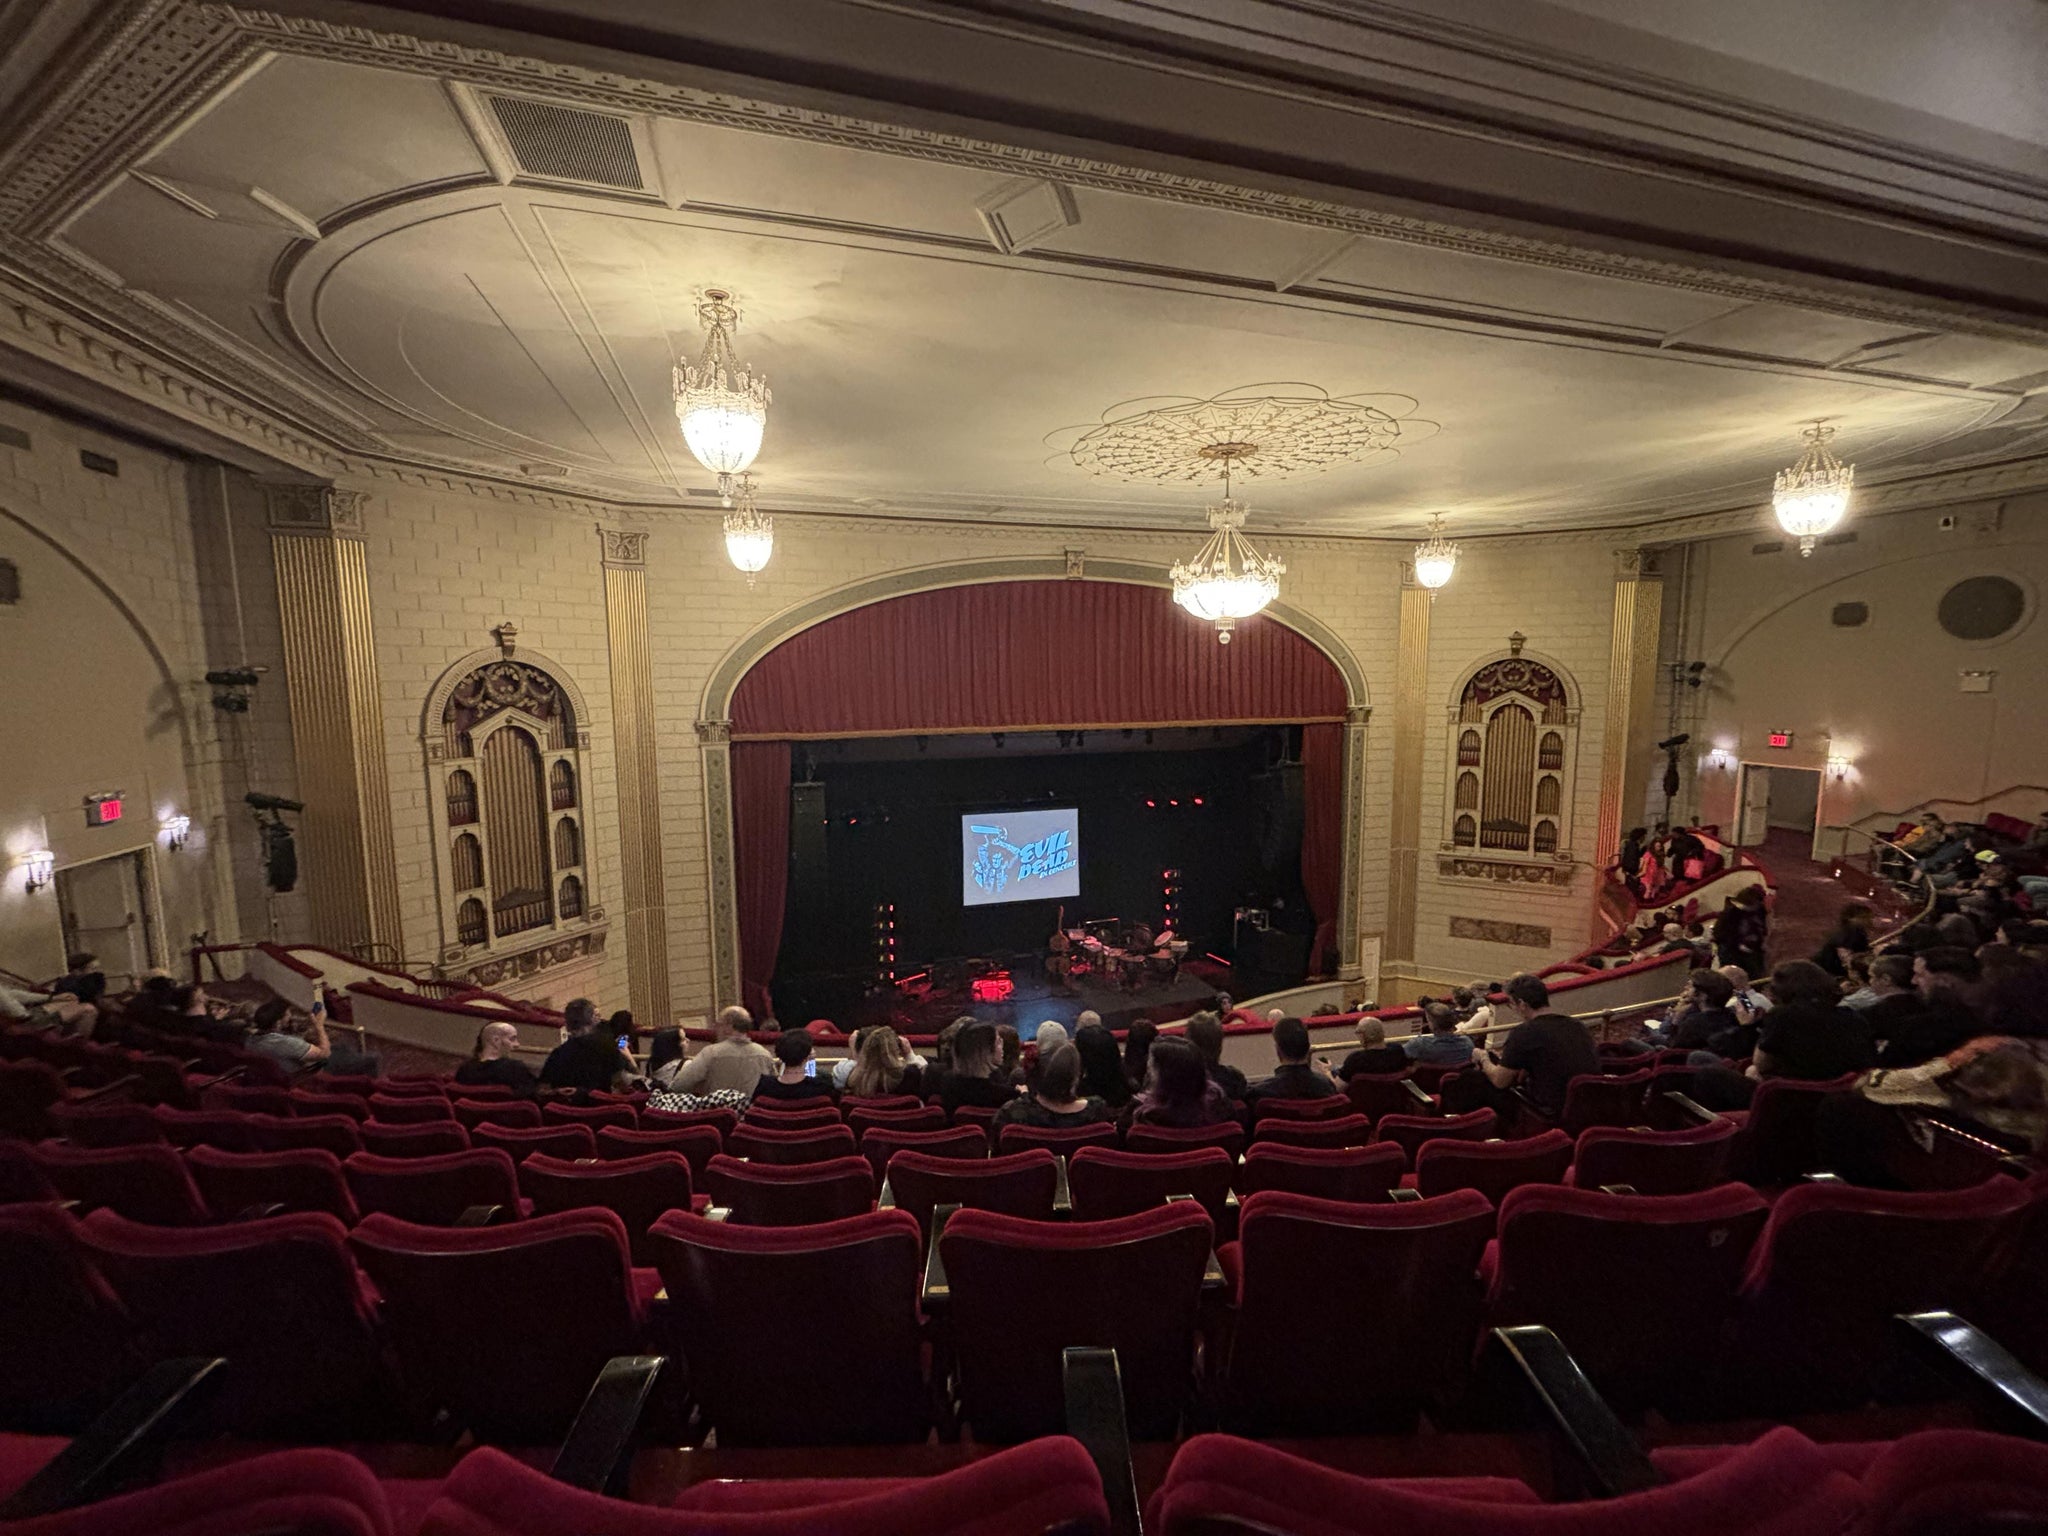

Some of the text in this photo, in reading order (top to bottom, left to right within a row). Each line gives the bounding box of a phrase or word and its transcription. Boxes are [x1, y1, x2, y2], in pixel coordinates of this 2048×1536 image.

[1769, 735, 1787, 747] EXIT
[1019, 829, 1072, 864] EVIL
[1017, 850, 1069, 882] DEAD
[1048, 859, 1077, 876] CONCERT
